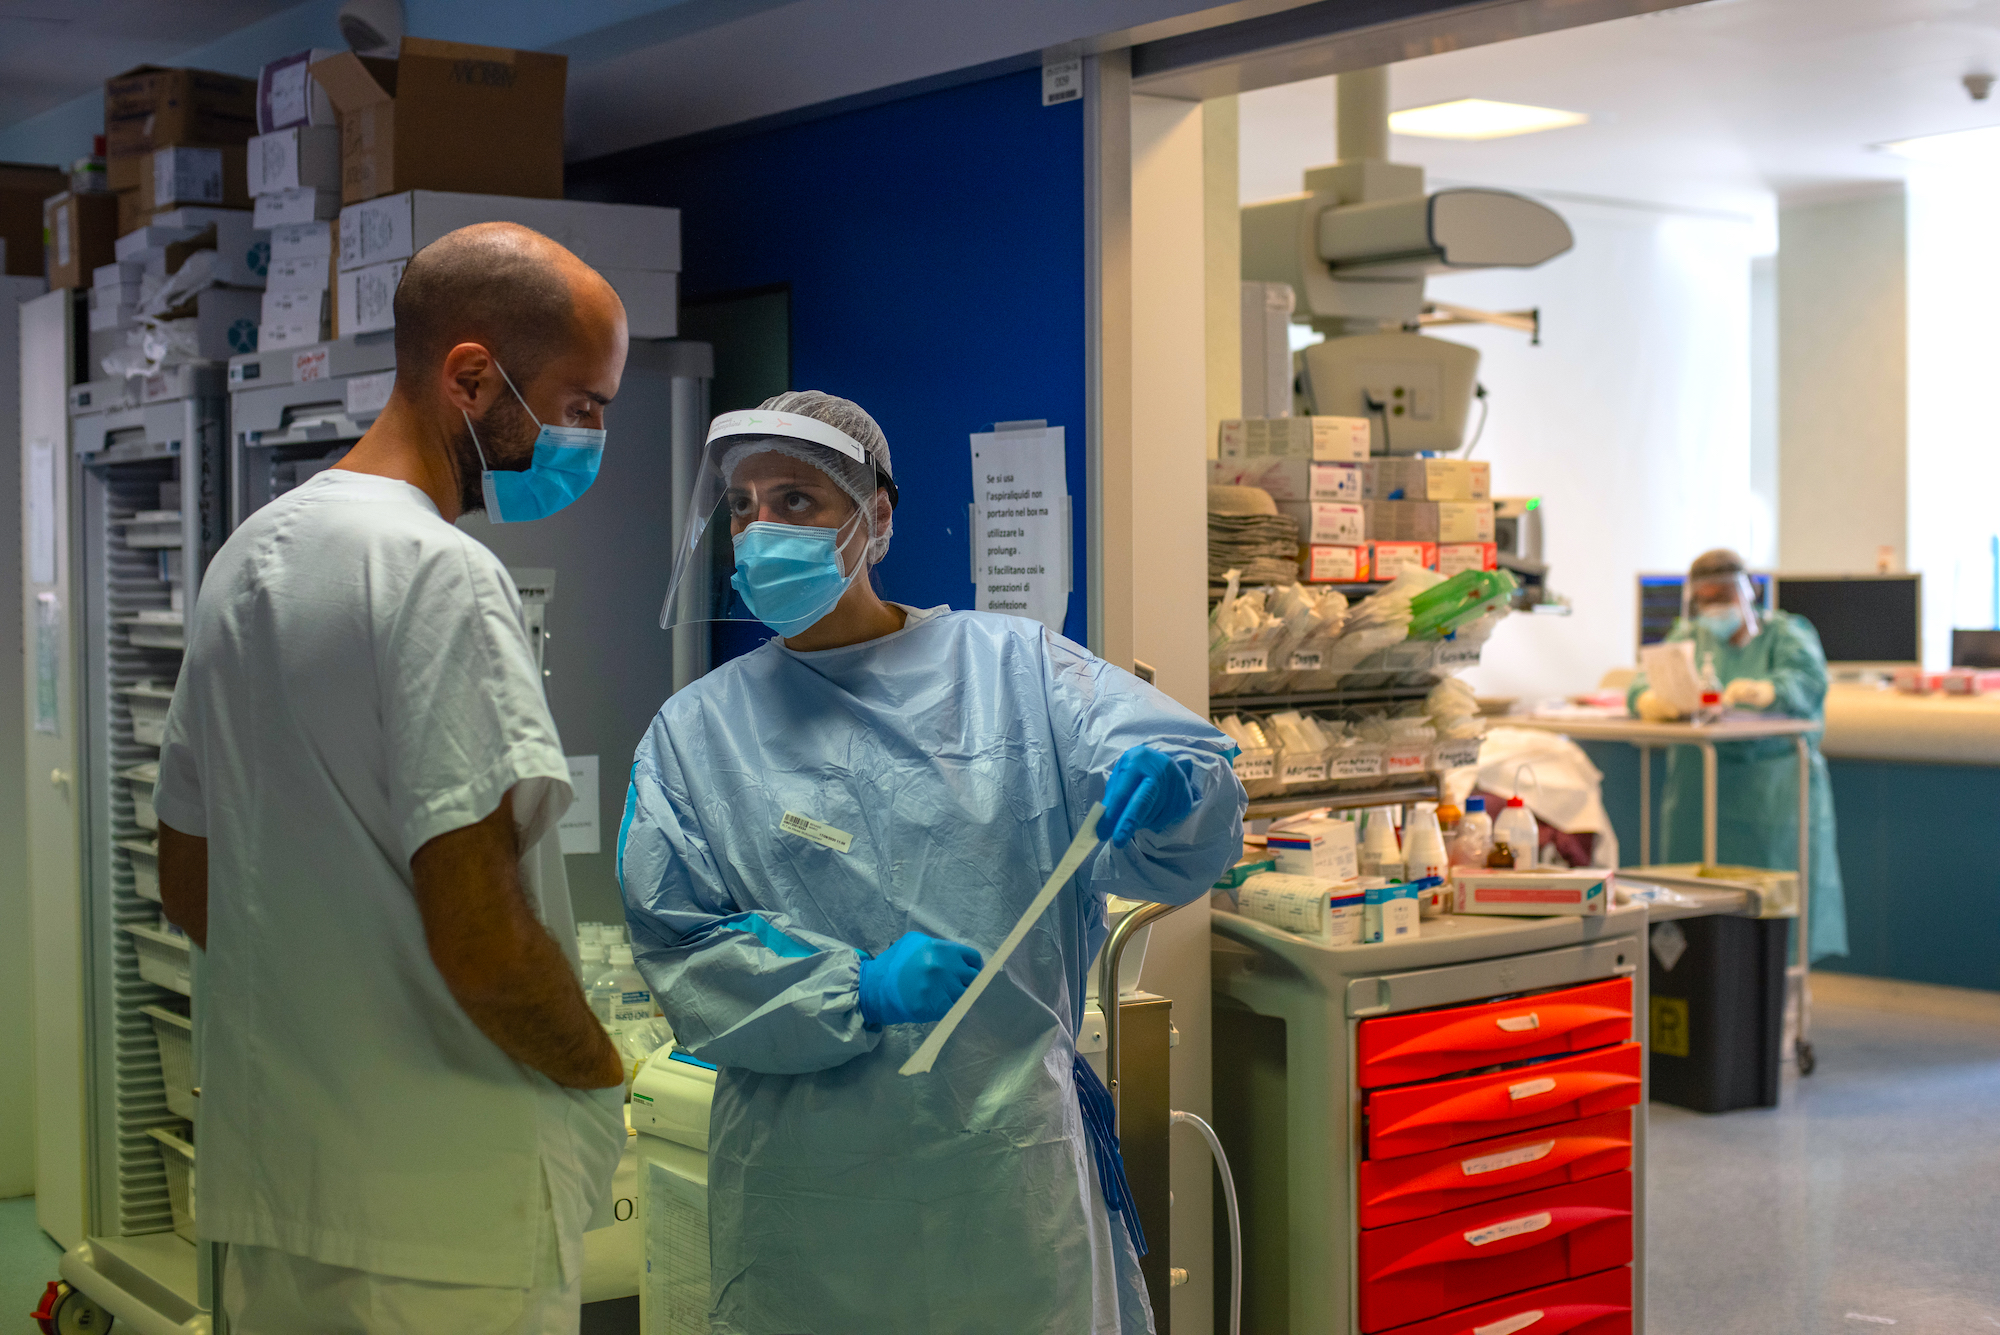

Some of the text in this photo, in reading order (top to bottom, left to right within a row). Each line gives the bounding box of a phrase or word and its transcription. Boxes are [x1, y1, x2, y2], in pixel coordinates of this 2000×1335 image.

[986, 474, 1014, 484] Se si usa
[986, 489, 1043, 502] l'aspiraliquidi non
[987, 507, 1049, 520] portarlo nel box ma
[987, 528, 1024, 538] utilizzare la
[988, 566, 993, 575] Si
[994, 565, 1025, 575] facilitano
[1039, 564, 1045, 574] le
[988, 582, 1030, 594] operazioni di
[988, 599, 1027, 610] disinfezione
